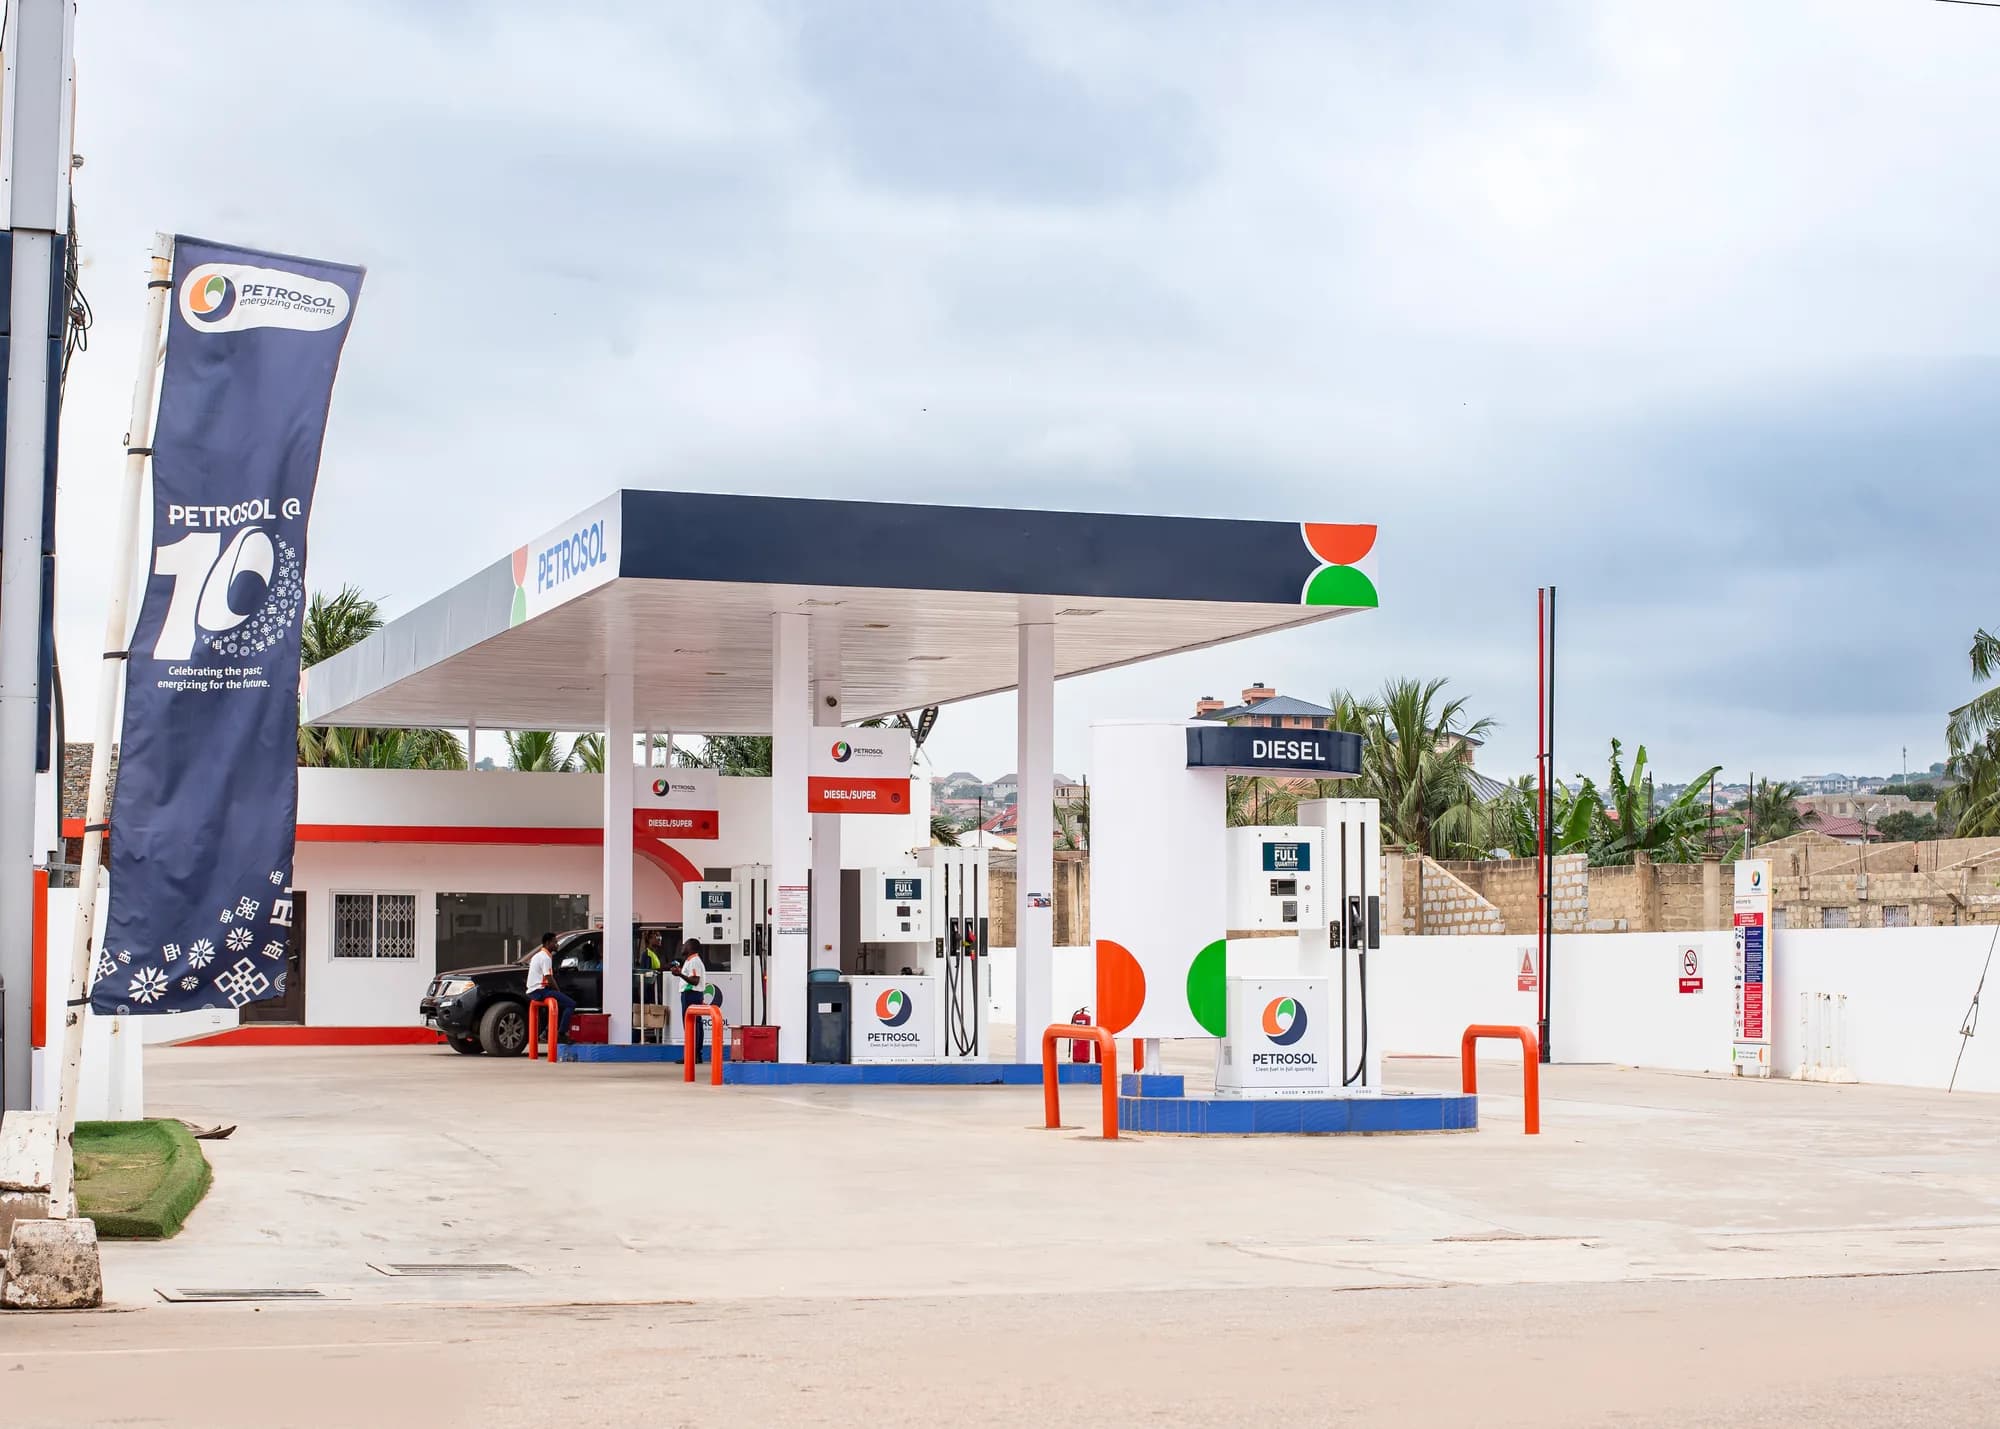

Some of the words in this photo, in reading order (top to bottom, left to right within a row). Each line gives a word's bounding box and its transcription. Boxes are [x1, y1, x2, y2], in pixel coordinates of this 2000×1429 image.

[242, 284, 335, 308] PETROSOL
[240, 297, 291, 310] energizing
[293, 303, 335, 316] dreams!
[168, 499, 277, 528] PETROSOL
[281, 498, 302, 520] @
[538, 519, 607, 594] PETROSOL
[153, 526, 275, 660] 10
[168, 665, 223, 679] Celebrating
[224, 666, 241, 676] the
[157, 679, 208, 692] energizing
[209, 679, 224, 689] for
[226, 680, 242, 689] the
[242, 679, 271, 689] future.
[1252, 740, 1326, 761] DIESEL
[823, 789, 877, 800] DIESEL/SUPER
[648, 819, 693, 828] DIESEL/SUPER
[1274, 849, 1298, 861] FULL
[895, 883, 913, 892] FULL
[708, 895, 724, 903] FULL
[867, 1032, 921, 1042] PETROSOL
[1252, 1053, 1318, 1065] PETROSOL
